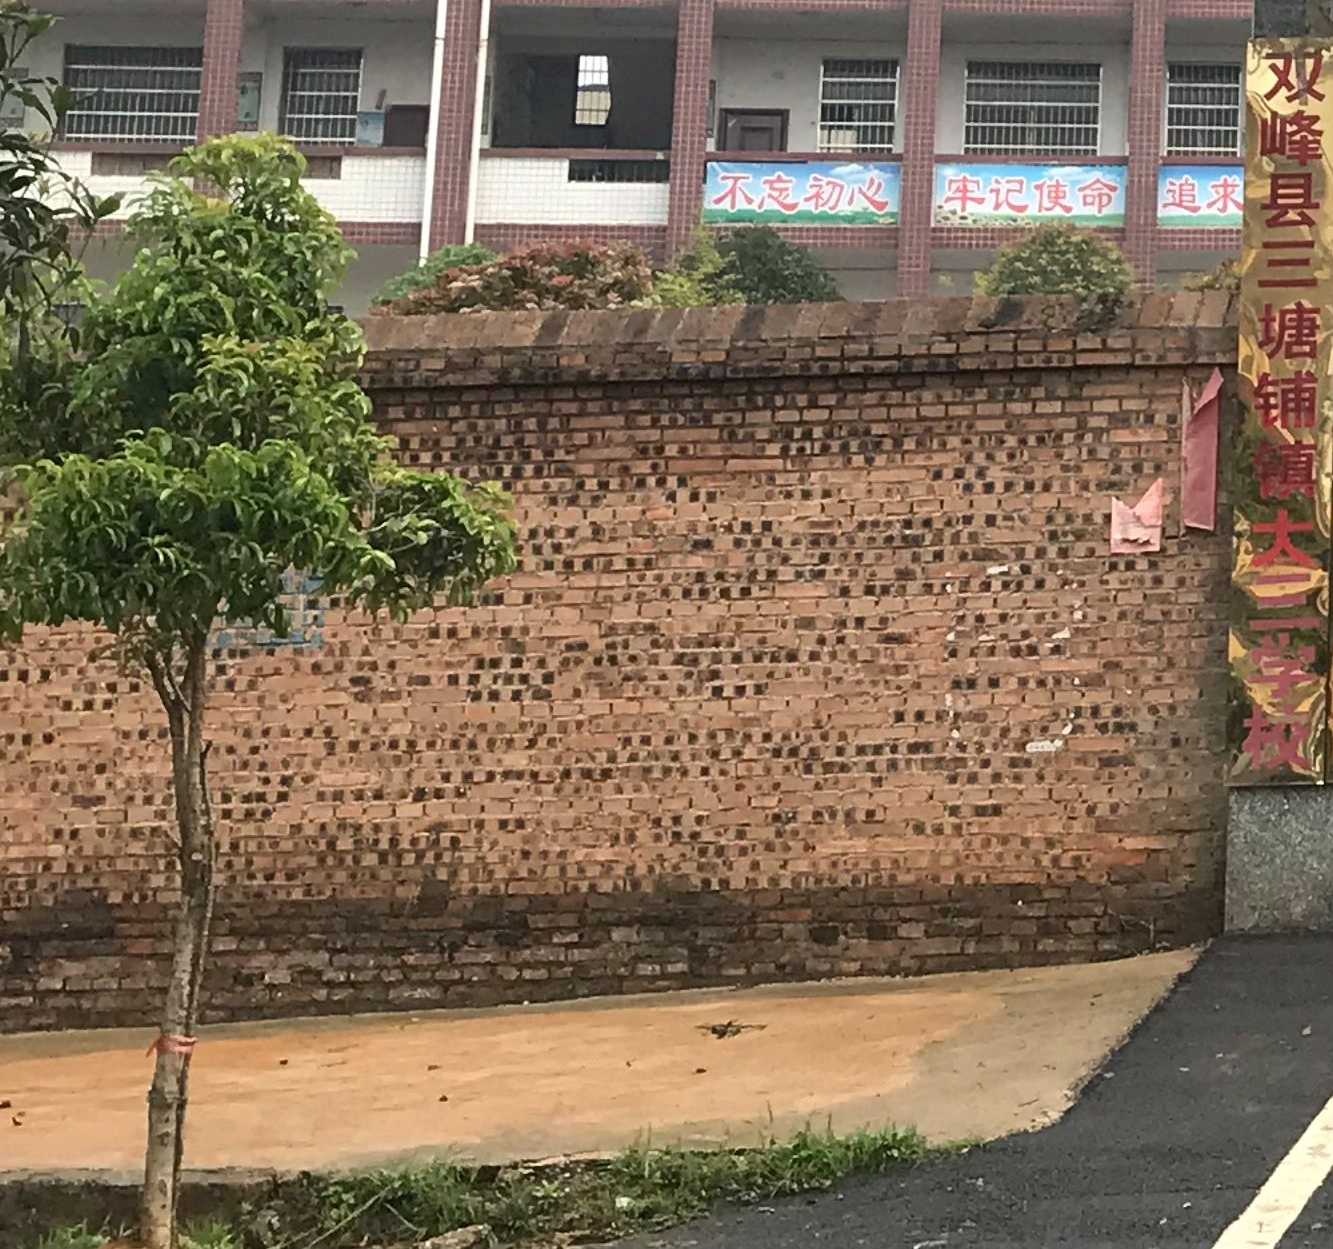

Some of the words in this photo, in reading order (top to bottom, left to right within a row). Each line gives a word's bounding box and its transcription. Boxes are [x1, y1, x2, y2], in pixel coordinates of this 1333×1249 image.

[712, 173, 890, 213] 不忘初心
[944, 175, 1119, 215] 牢记使命
[1162, 177, 1244, 214] 追求
[1242, 49, 1326, 771] 双峰县三塘铺镇大三学校
